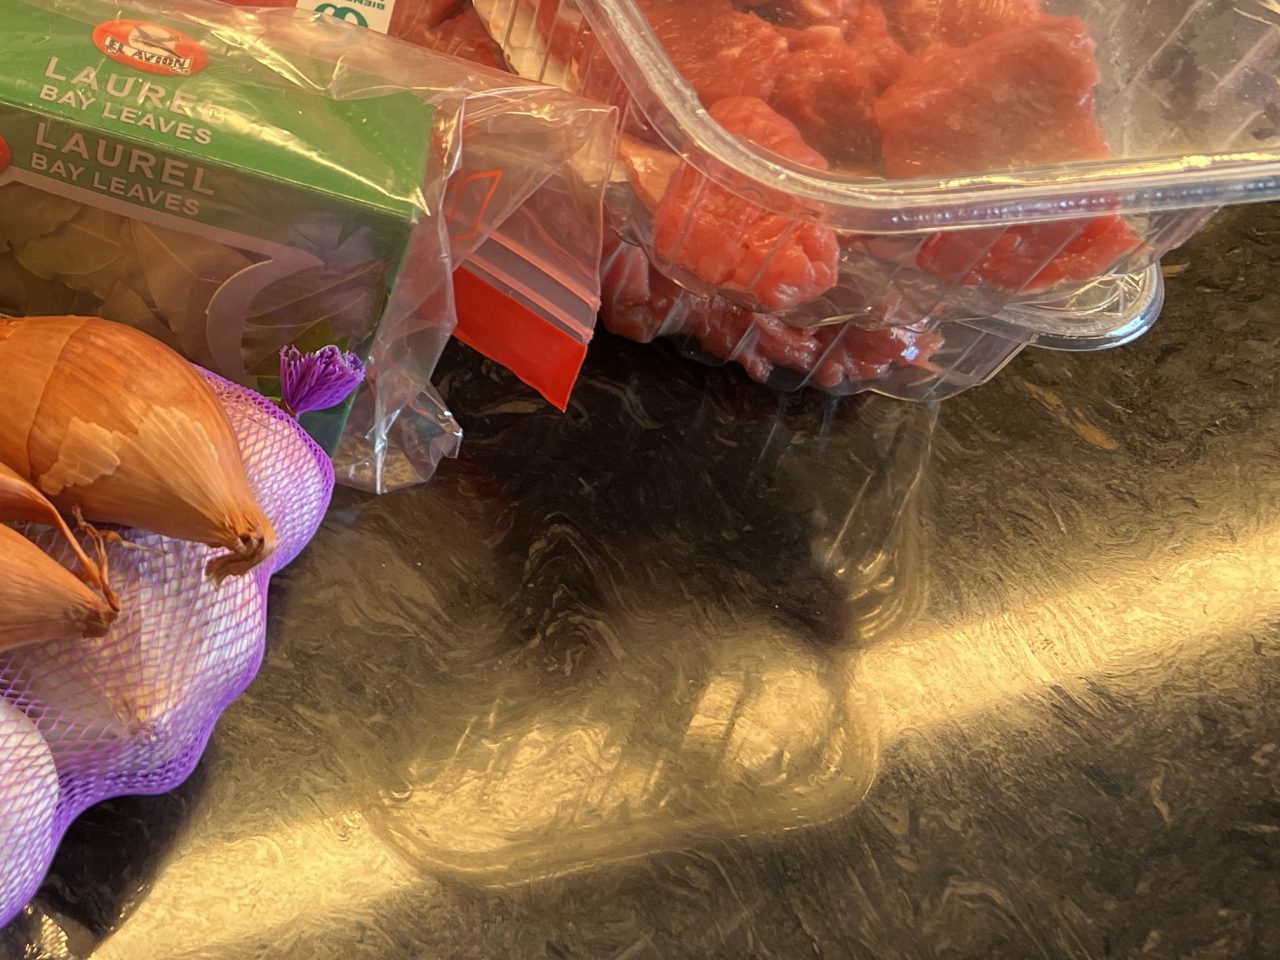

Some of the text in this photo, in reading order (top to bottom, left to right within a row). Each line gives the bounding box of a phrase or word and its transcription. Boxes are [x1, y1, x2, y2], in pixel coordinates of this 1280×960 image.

[108, 39, 187, 67] EL AVION
[39, 84, 212, 145] BAY LEAVES
[44, 56, 225, 125] LAUREL
[30, 152, 201, 216] BAY LEAVES
[35, 122, 215, 195] LAUREL
